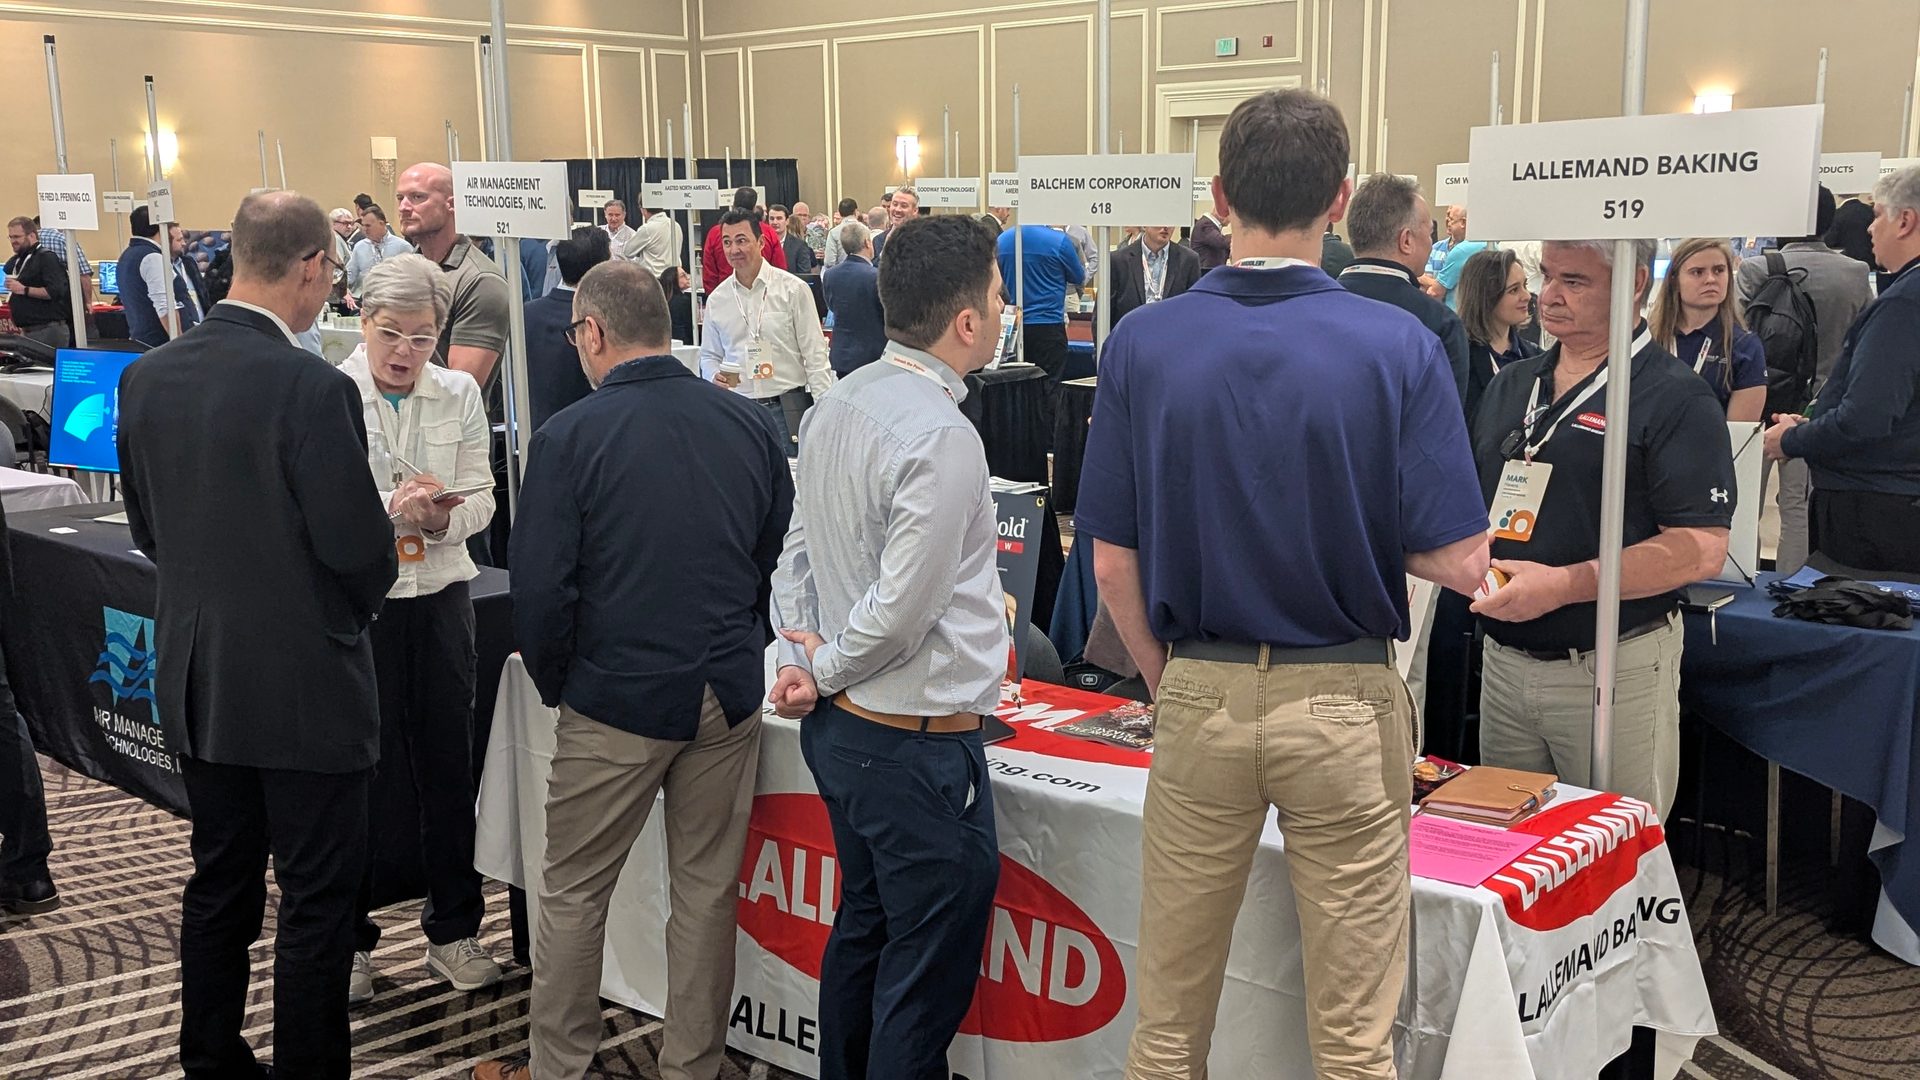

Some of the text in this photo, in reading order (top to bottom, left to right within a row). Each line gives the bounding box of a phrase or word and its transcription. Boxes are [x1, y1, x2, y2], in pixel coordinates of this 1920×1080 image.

[1512, 151, 1759, 181] LALLEMAND BAKING
[466, 176, 541, 191] AIR MANAGEMENT
[1030, 176, 1182, 190] BALCHEM CORPORATION
[1445, 177, 1460, 185] CSM
[45, 192, 55, 202] FRED
[60, 192, 81, 202] PFENING
[81, 193, 92, 203] CO.
[464, 194, 547, 211] TECHNOLOGIES, INC.
[1090, 202, 1112, 215] 618
[1603, 199, 1645, 220] 519
[58, 211, 67, 221] 523
[496, 221, 510, 234] 521
[1505, 474, 1529, 484] MARK
[113, 712, 166, 750] MANAGE
